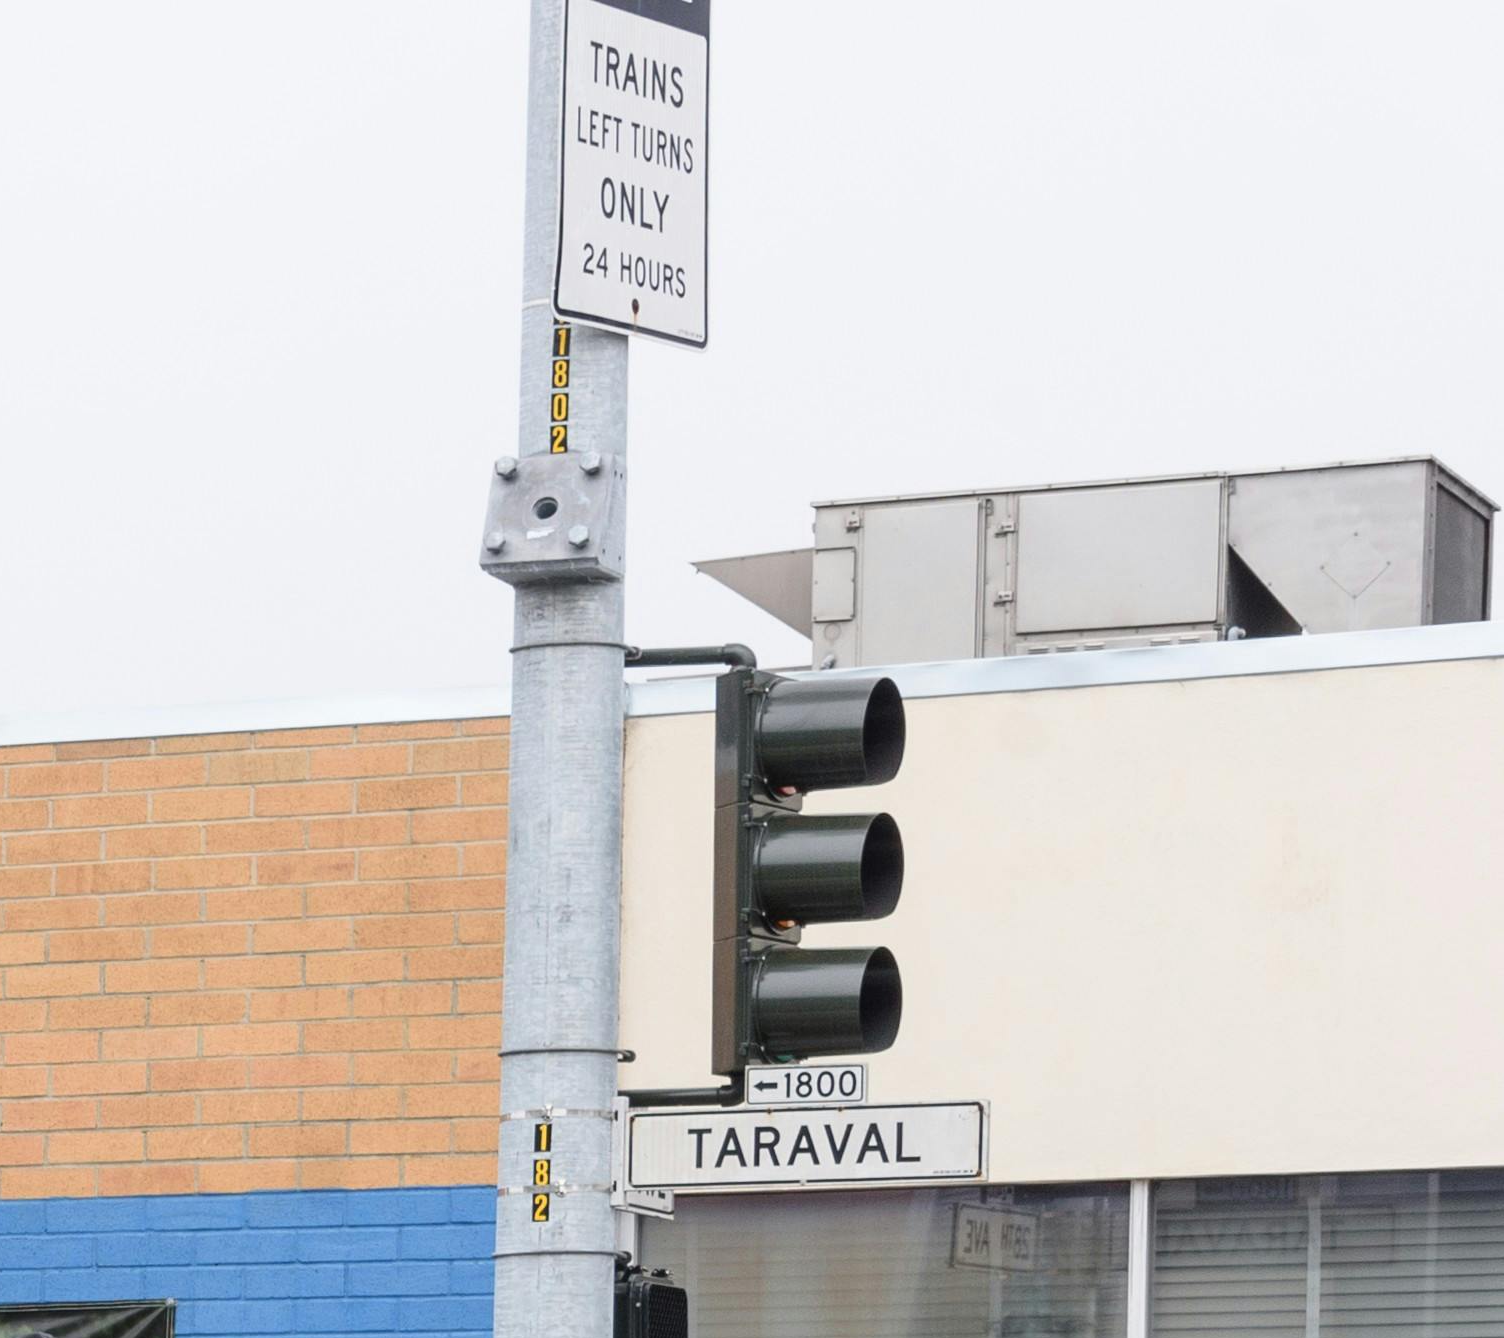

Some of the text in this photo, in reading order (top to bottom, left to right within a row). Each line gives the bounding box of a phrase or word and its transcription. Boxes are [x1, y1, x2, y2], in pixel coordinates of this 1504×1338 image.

[590, 41, 684, 108] TRAINS
[577, 106, 694, 174] LEFT TURNS
[601, 177, 670, 233] ONLY
[583, 242, 686, 298] 24 HOURS
[552, 328, 568, 454] 1802
[784, 1071, 857, 1098] 1800
[534, 1124, 549, 1222] 182
[688, 1122, 921, 1169] TARAVAL
